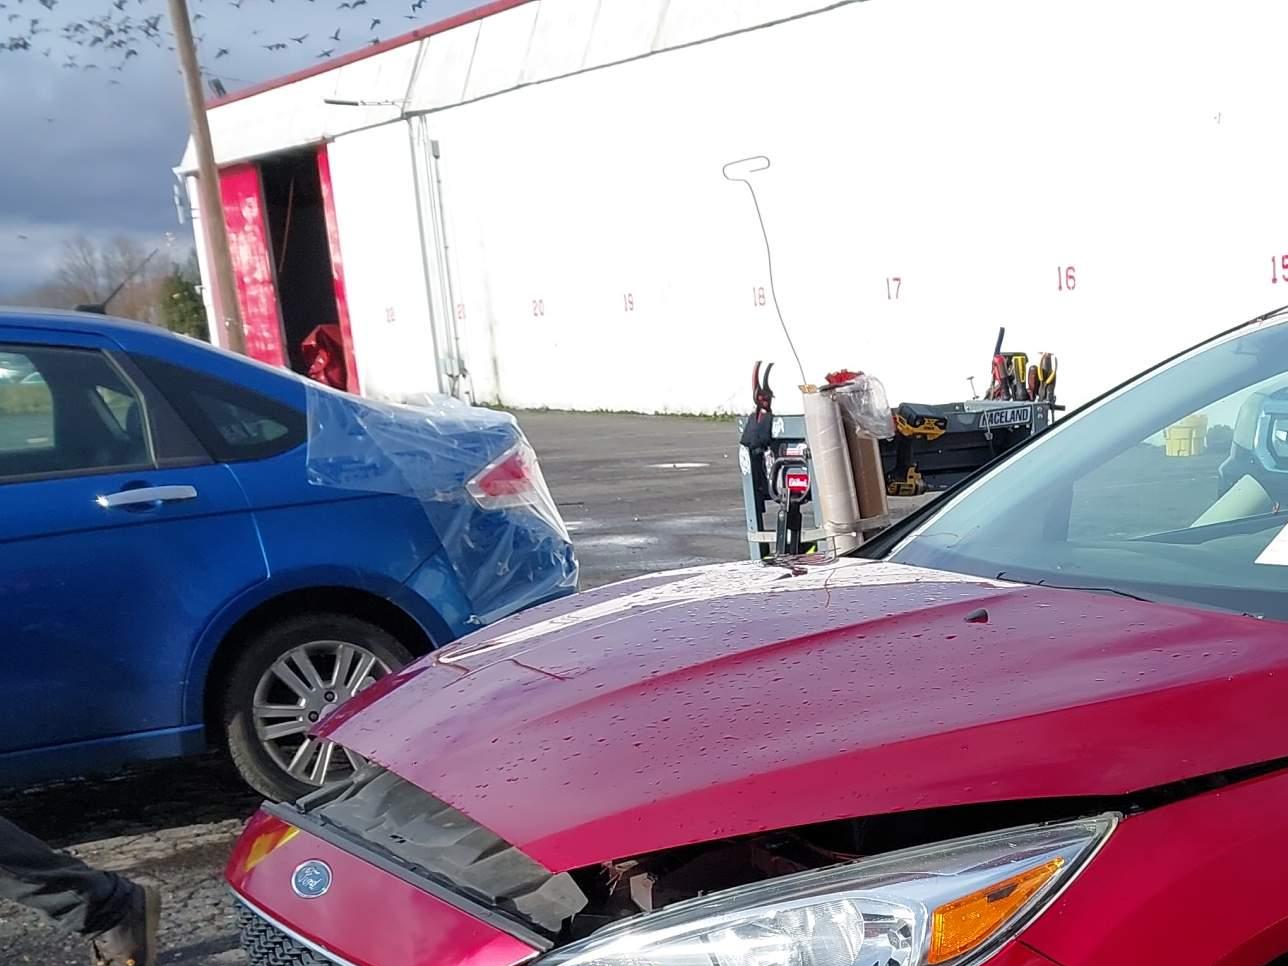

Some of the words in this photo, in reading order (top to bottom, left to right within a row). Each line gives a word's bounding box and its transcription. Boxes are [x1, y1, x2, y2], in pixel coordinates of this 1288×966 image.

[886, 277, 901, 300] 17
[1057, 266, 1076, 291] 16
[624, 293, 634, 312] 19
[753, 287, 766, 307] 18
